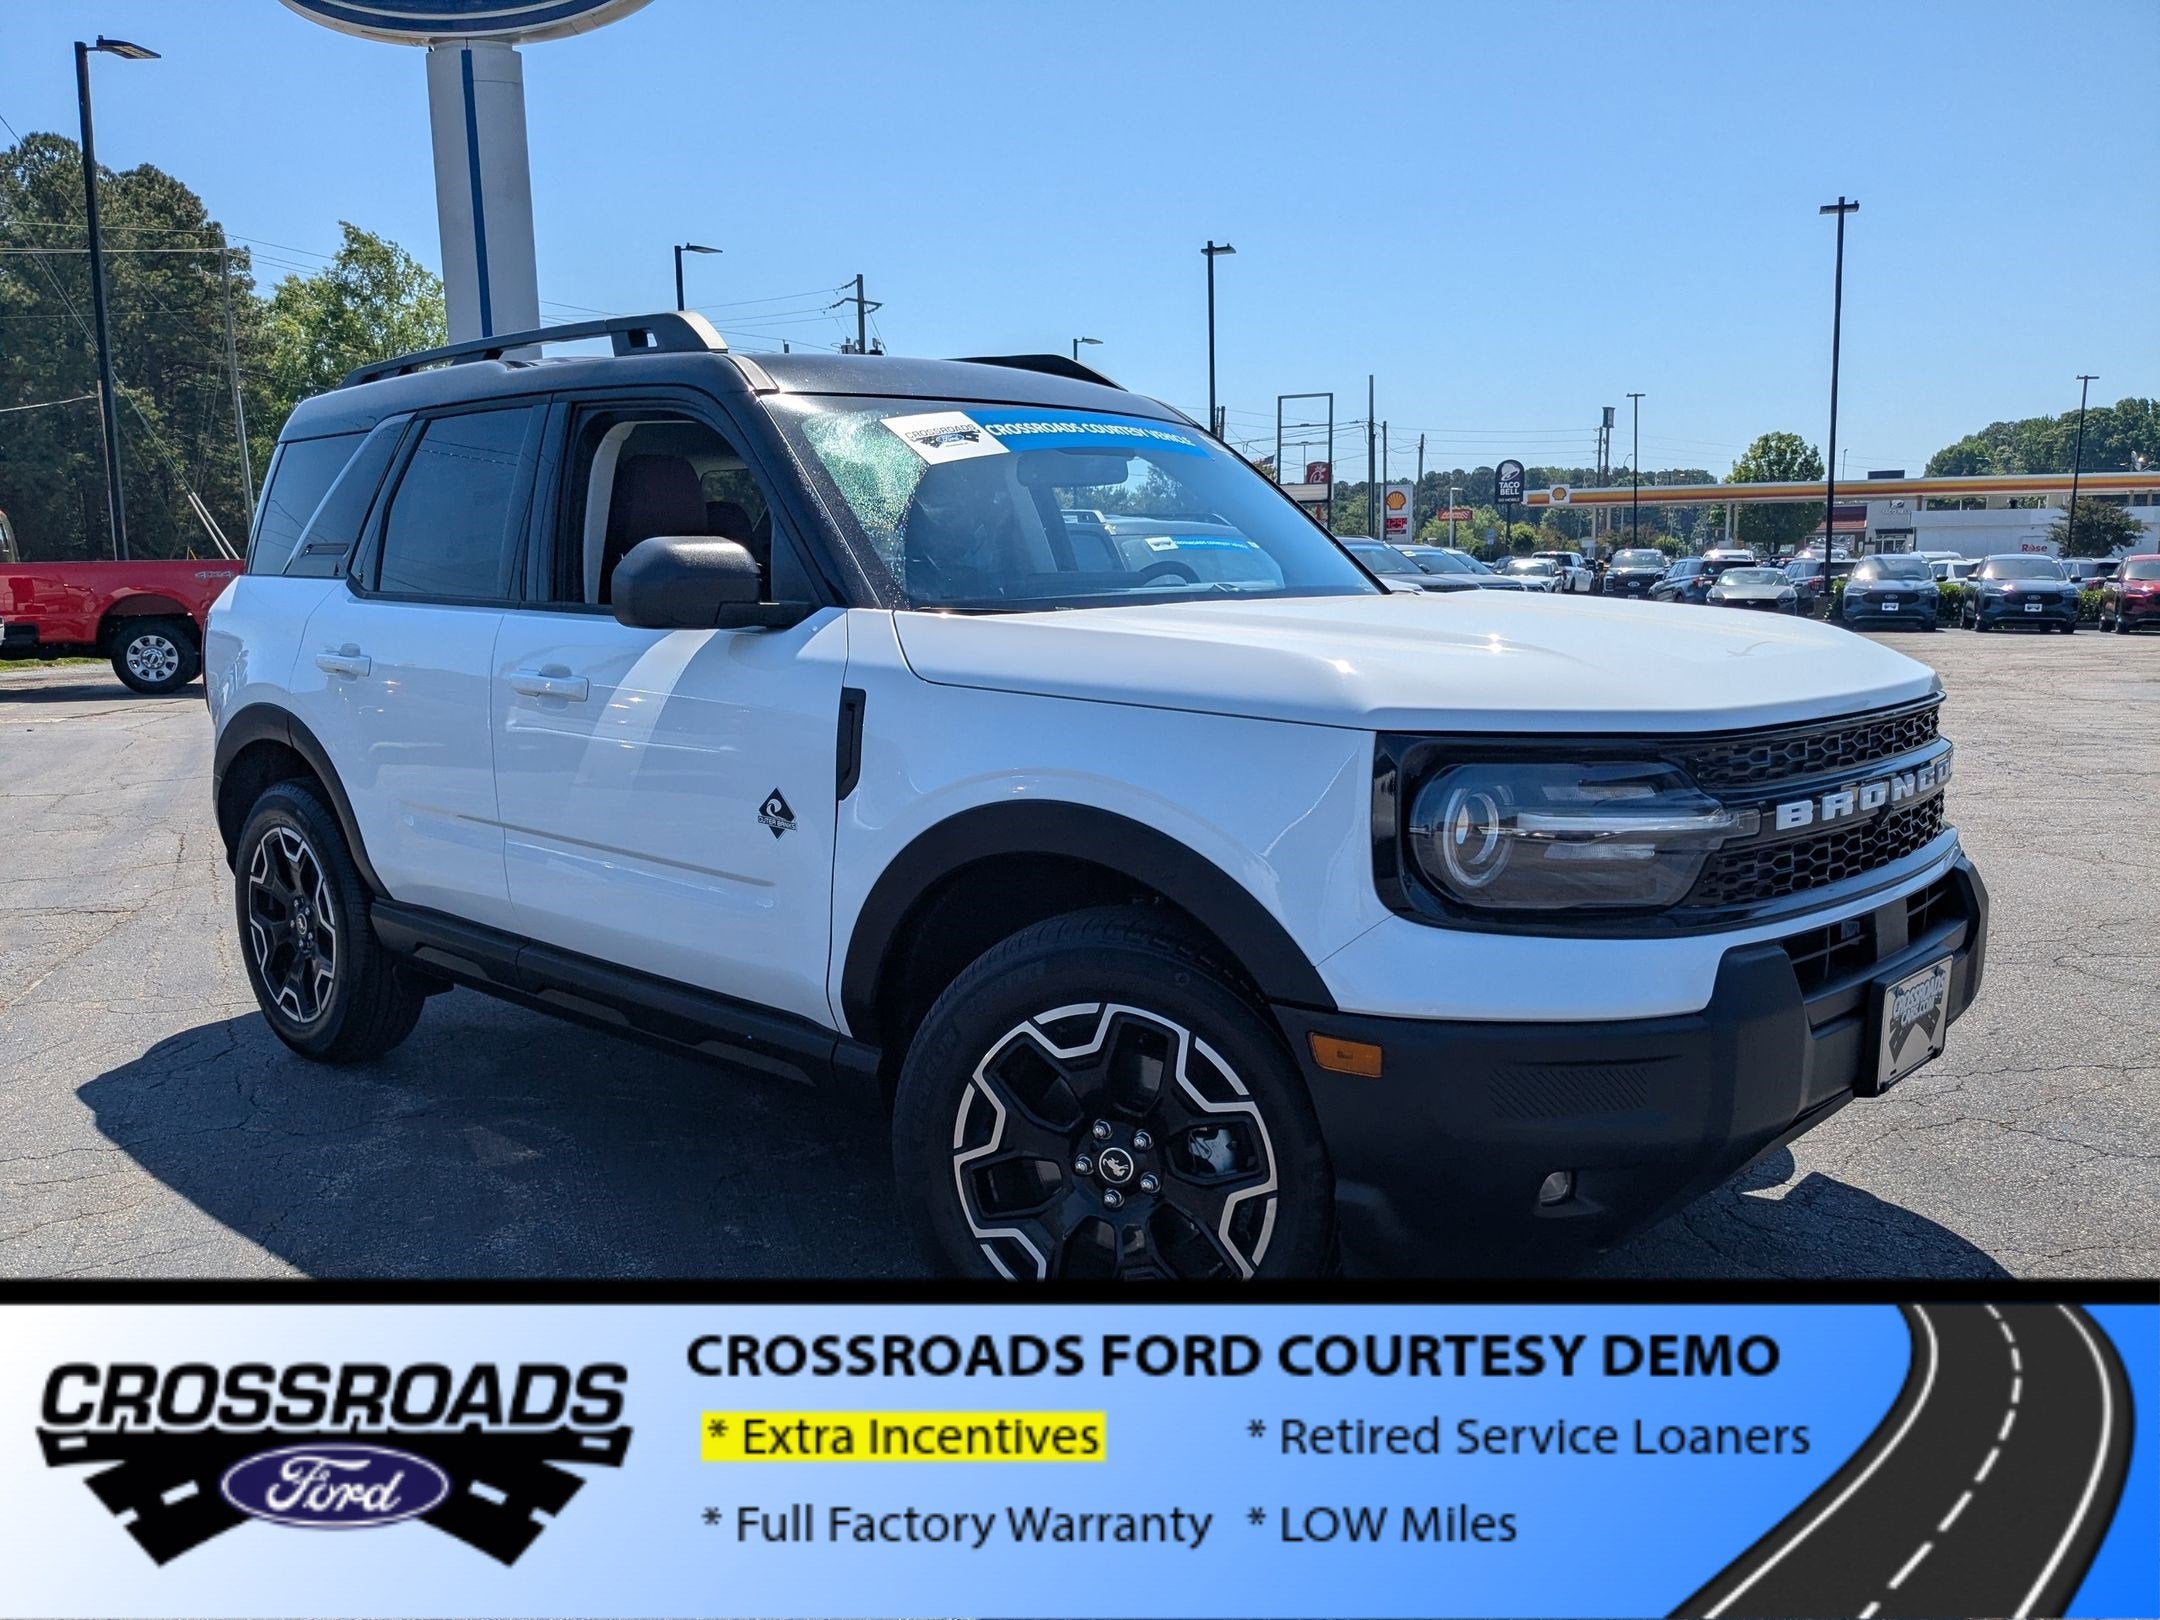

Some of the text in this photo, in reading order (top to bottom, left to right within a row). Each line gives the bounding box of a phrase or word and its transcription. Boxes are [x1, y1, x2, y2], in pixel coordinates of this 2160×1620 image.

[904, 423, 977, 440] CROSSROADS
[985, 422, 1083, 436] CROSSROADS
[1082, 423, 1149, 438] COURTESY
[1499, 481, 1520, 489] TACO
[1500, 488, 1520, 496] BELL
[1776, 757, 1952, 831] BRONCO
[1893, 973, 1946, 1019] CROSSROADS
